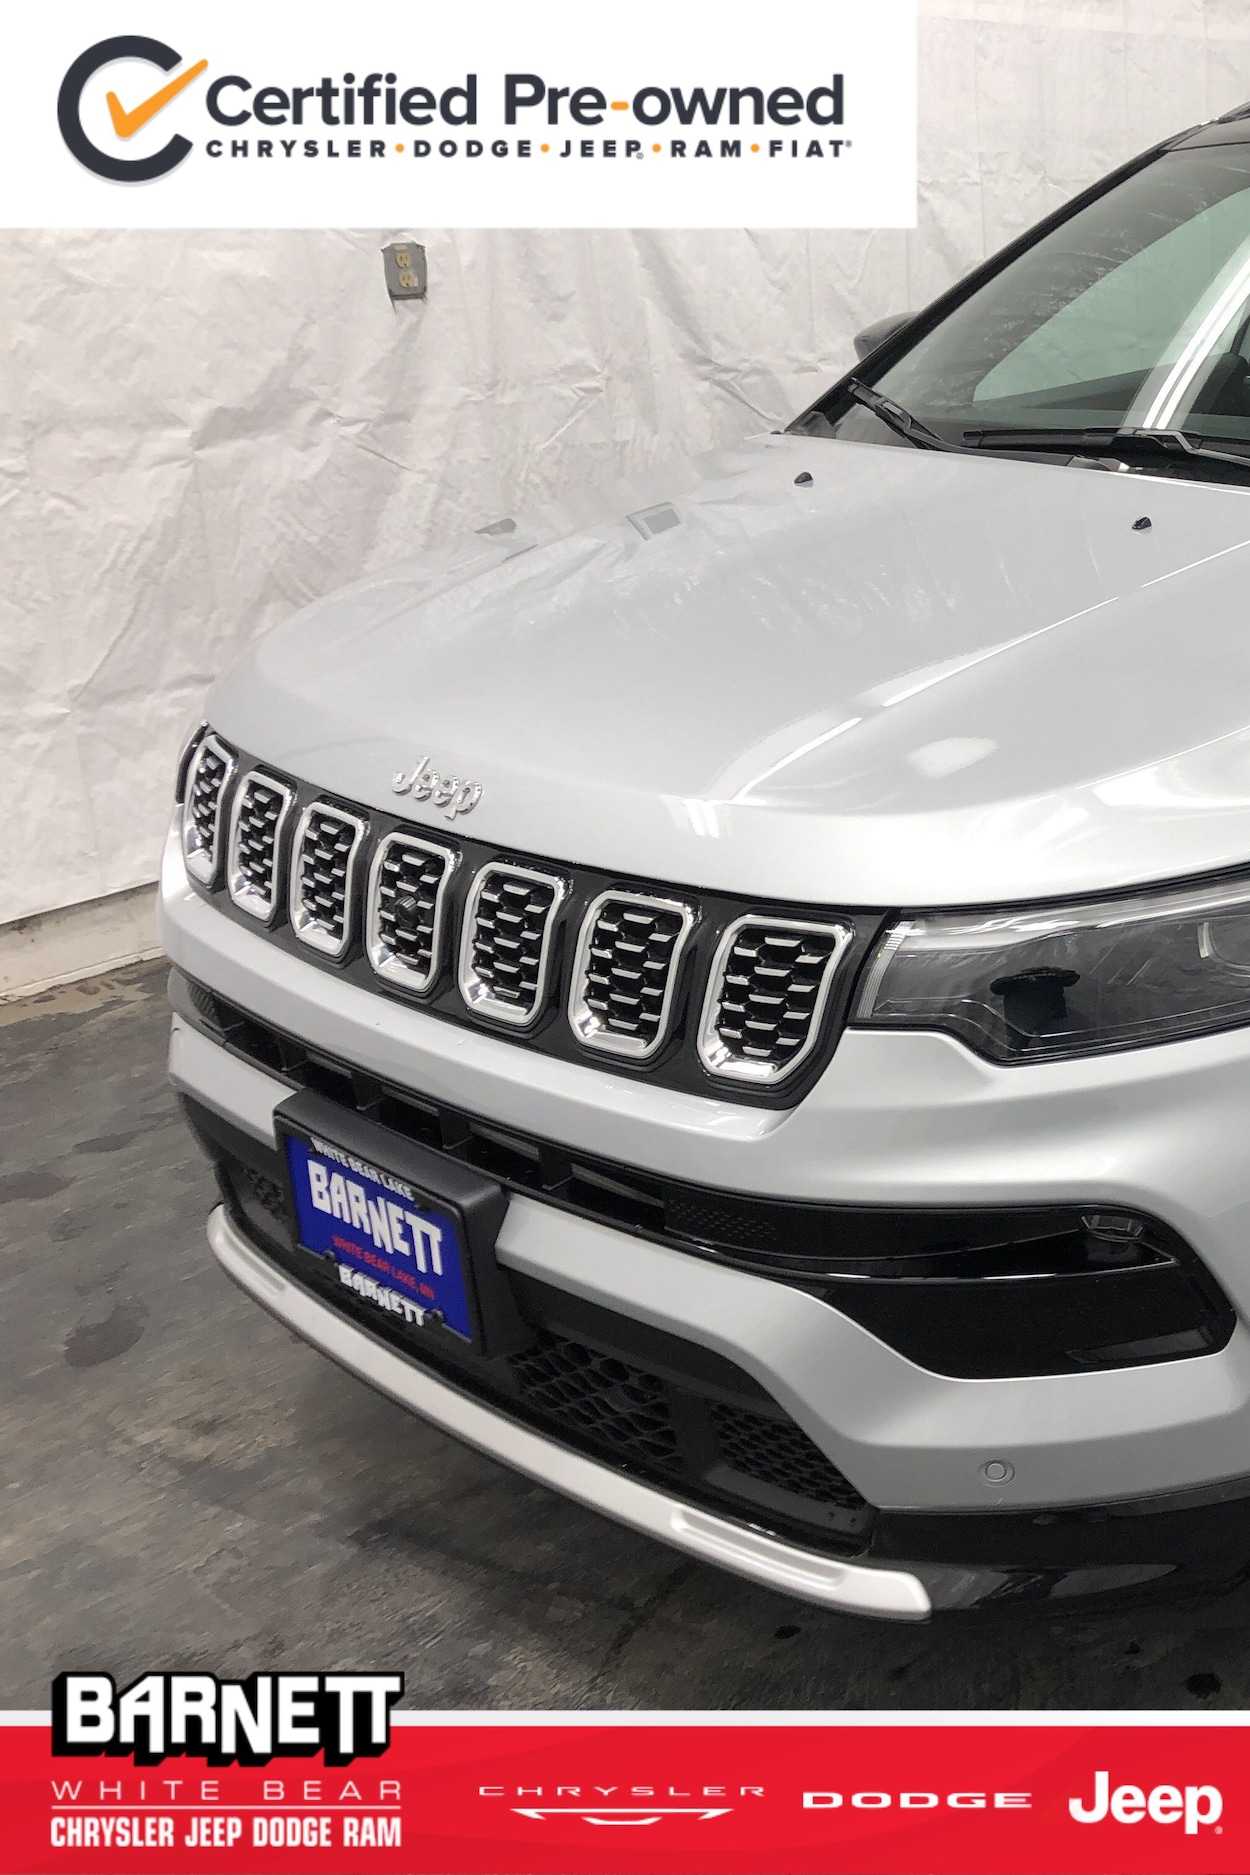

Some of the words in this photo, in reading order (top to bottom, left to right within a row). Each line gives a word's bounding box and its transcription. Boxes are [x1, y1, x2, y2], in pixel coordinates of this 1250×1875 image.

[391, 755, 485, 820] Jeep
[310, 1137, 350, 1168] WHITE
[347, 1157, 381, 1185] BEAR
[380, 1173, 415, 1201] LAKE
[307, 1159, 443, 1275] BARNETT
[338, 1263, 428, 1327] BARNETT
